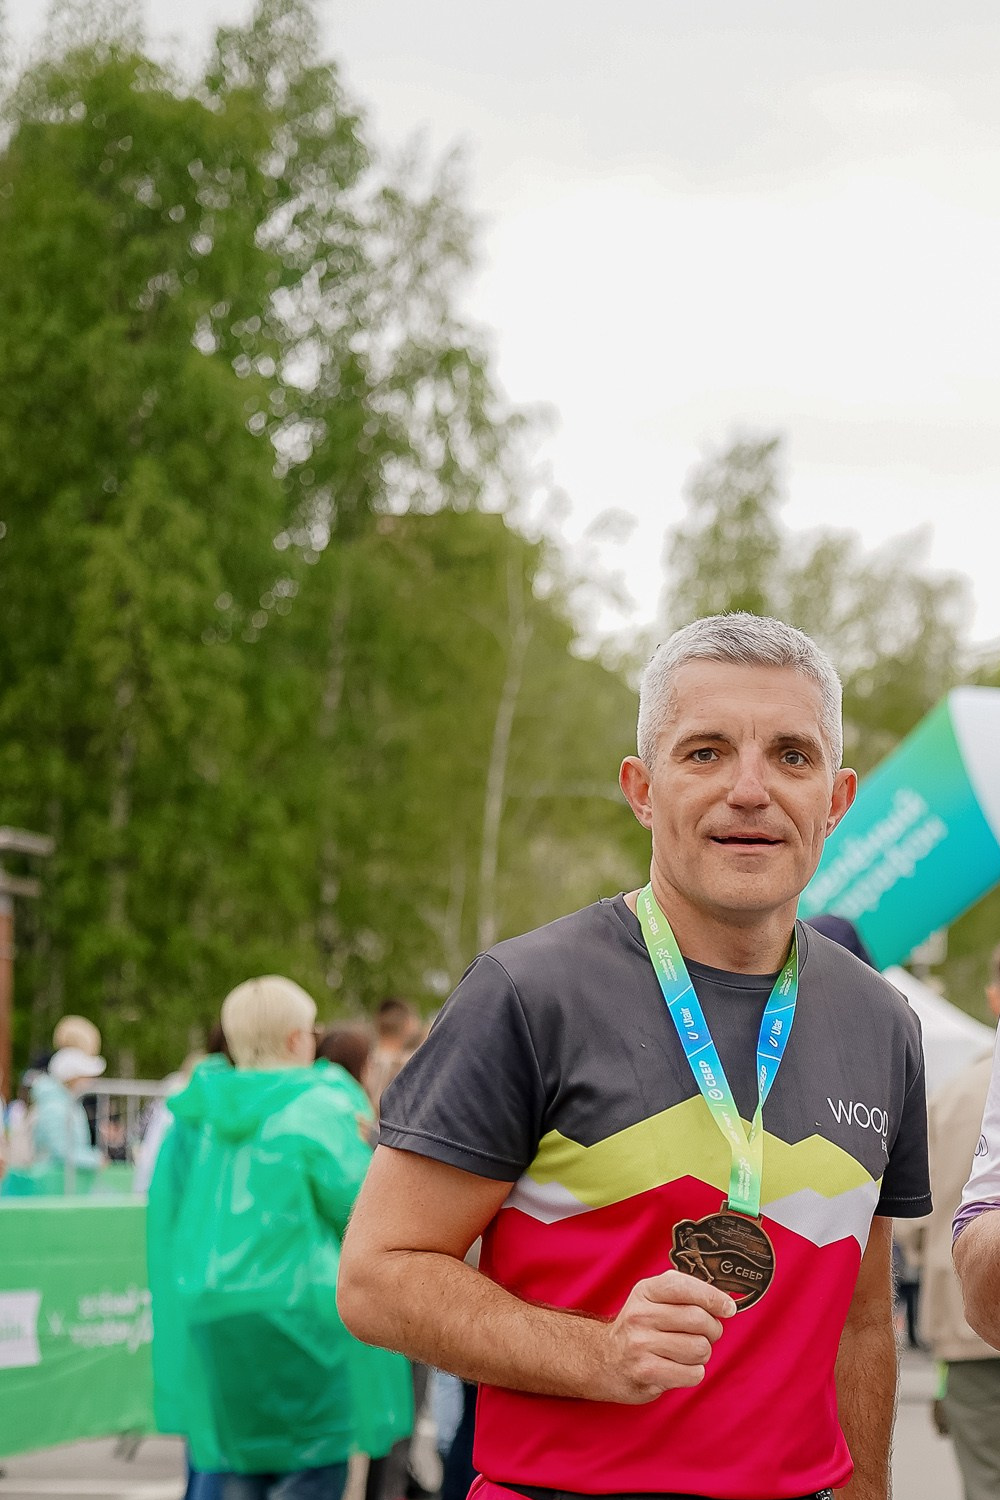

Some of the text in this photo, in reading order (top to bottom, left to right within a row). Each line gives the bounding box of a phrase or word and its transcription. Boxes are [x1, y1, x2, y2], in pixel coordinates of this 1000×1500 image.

[699, 1060, 717, 1087] СБЕР
[826, 1097, 889, 1137] WOOD
[734, 1266, 763, 1281] СБЕР
